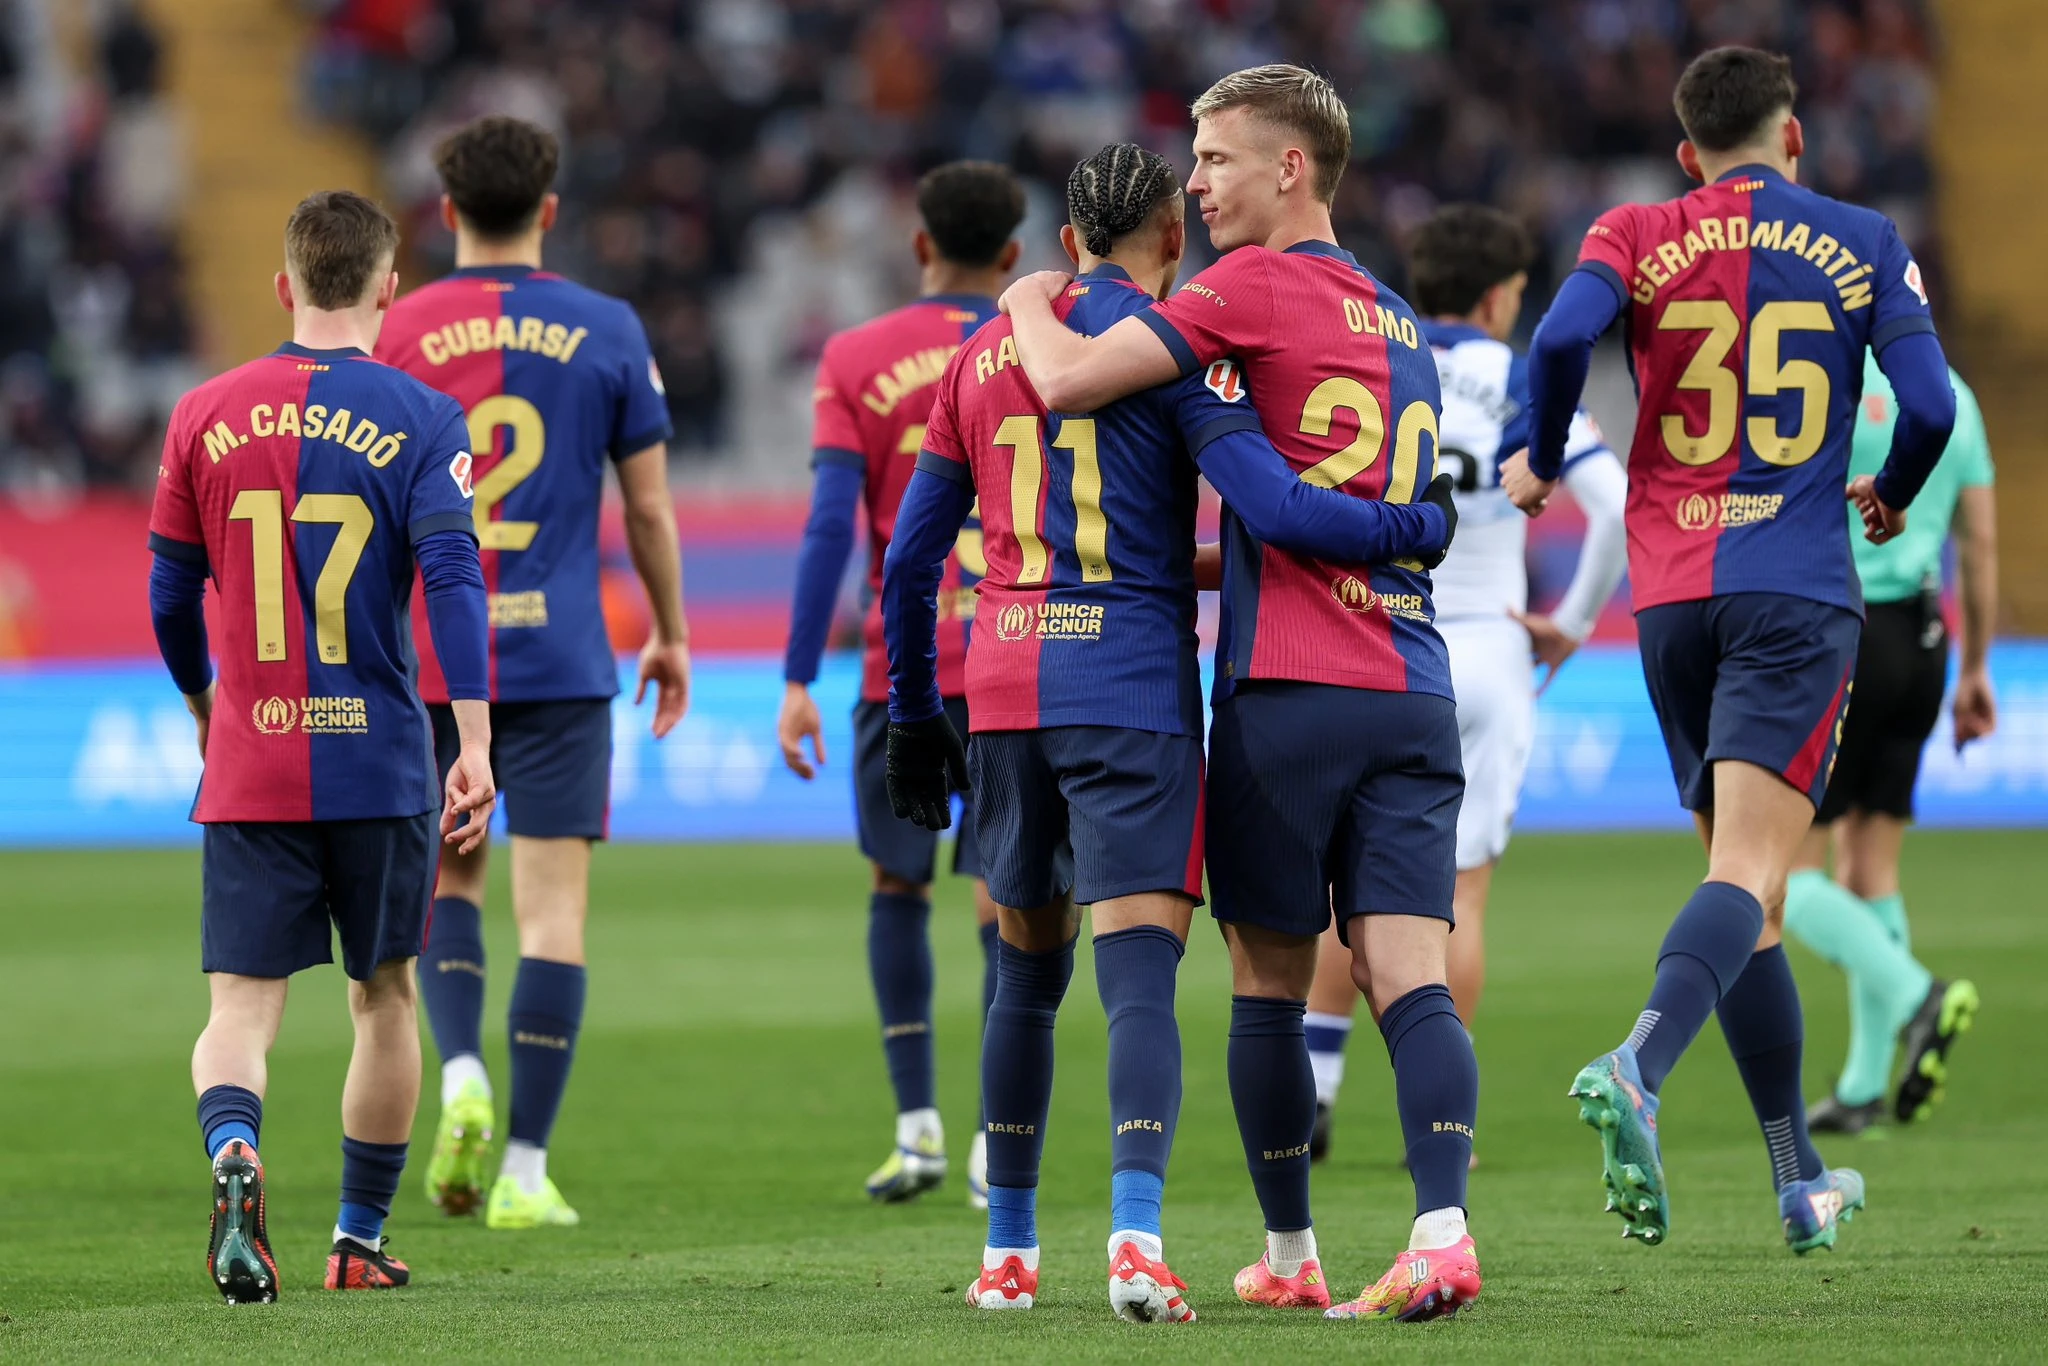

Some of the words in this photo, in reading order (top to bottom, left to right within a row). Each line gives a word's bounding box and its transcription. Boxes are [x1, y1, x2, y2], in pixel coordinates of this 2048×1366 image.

[1180, 282, 1216, 299] LIGHT
[1214, 295, 1227, 307] tv
[1342, 297, 1418, 350] OLMO
[419, 315, 588, 366] CUBARSÍ
[1657, 300, 1835, 466] 35
[202, 420, 249, 464] M.
[250, 403, 408, 468] CASADÓ
[467, 394, 546, 551] 2
[1299, 375, 1439, 573] 20
[992, 414, 1113, 585] 11
[1720, 494, 1784, 508] UNHCR
[228, 489, 375, 665] 17
[1037, 603, 1105, 618] UNHCR
[1035, 618, 1102, 633] ACNUR
[301, 697, 366, 712] UNHCR
[301, 712, 368, 727] ACNUR
[988, 1122, 1035, 1135] BARÇA
[1117, 1119, 1163, 1136] BARÇA
[1432, 1121, 1474, 1141] BARÇA
[1263, 1142, 1309, 1160] BARÇA
[1409, 1257, 1428, 1285] 10
